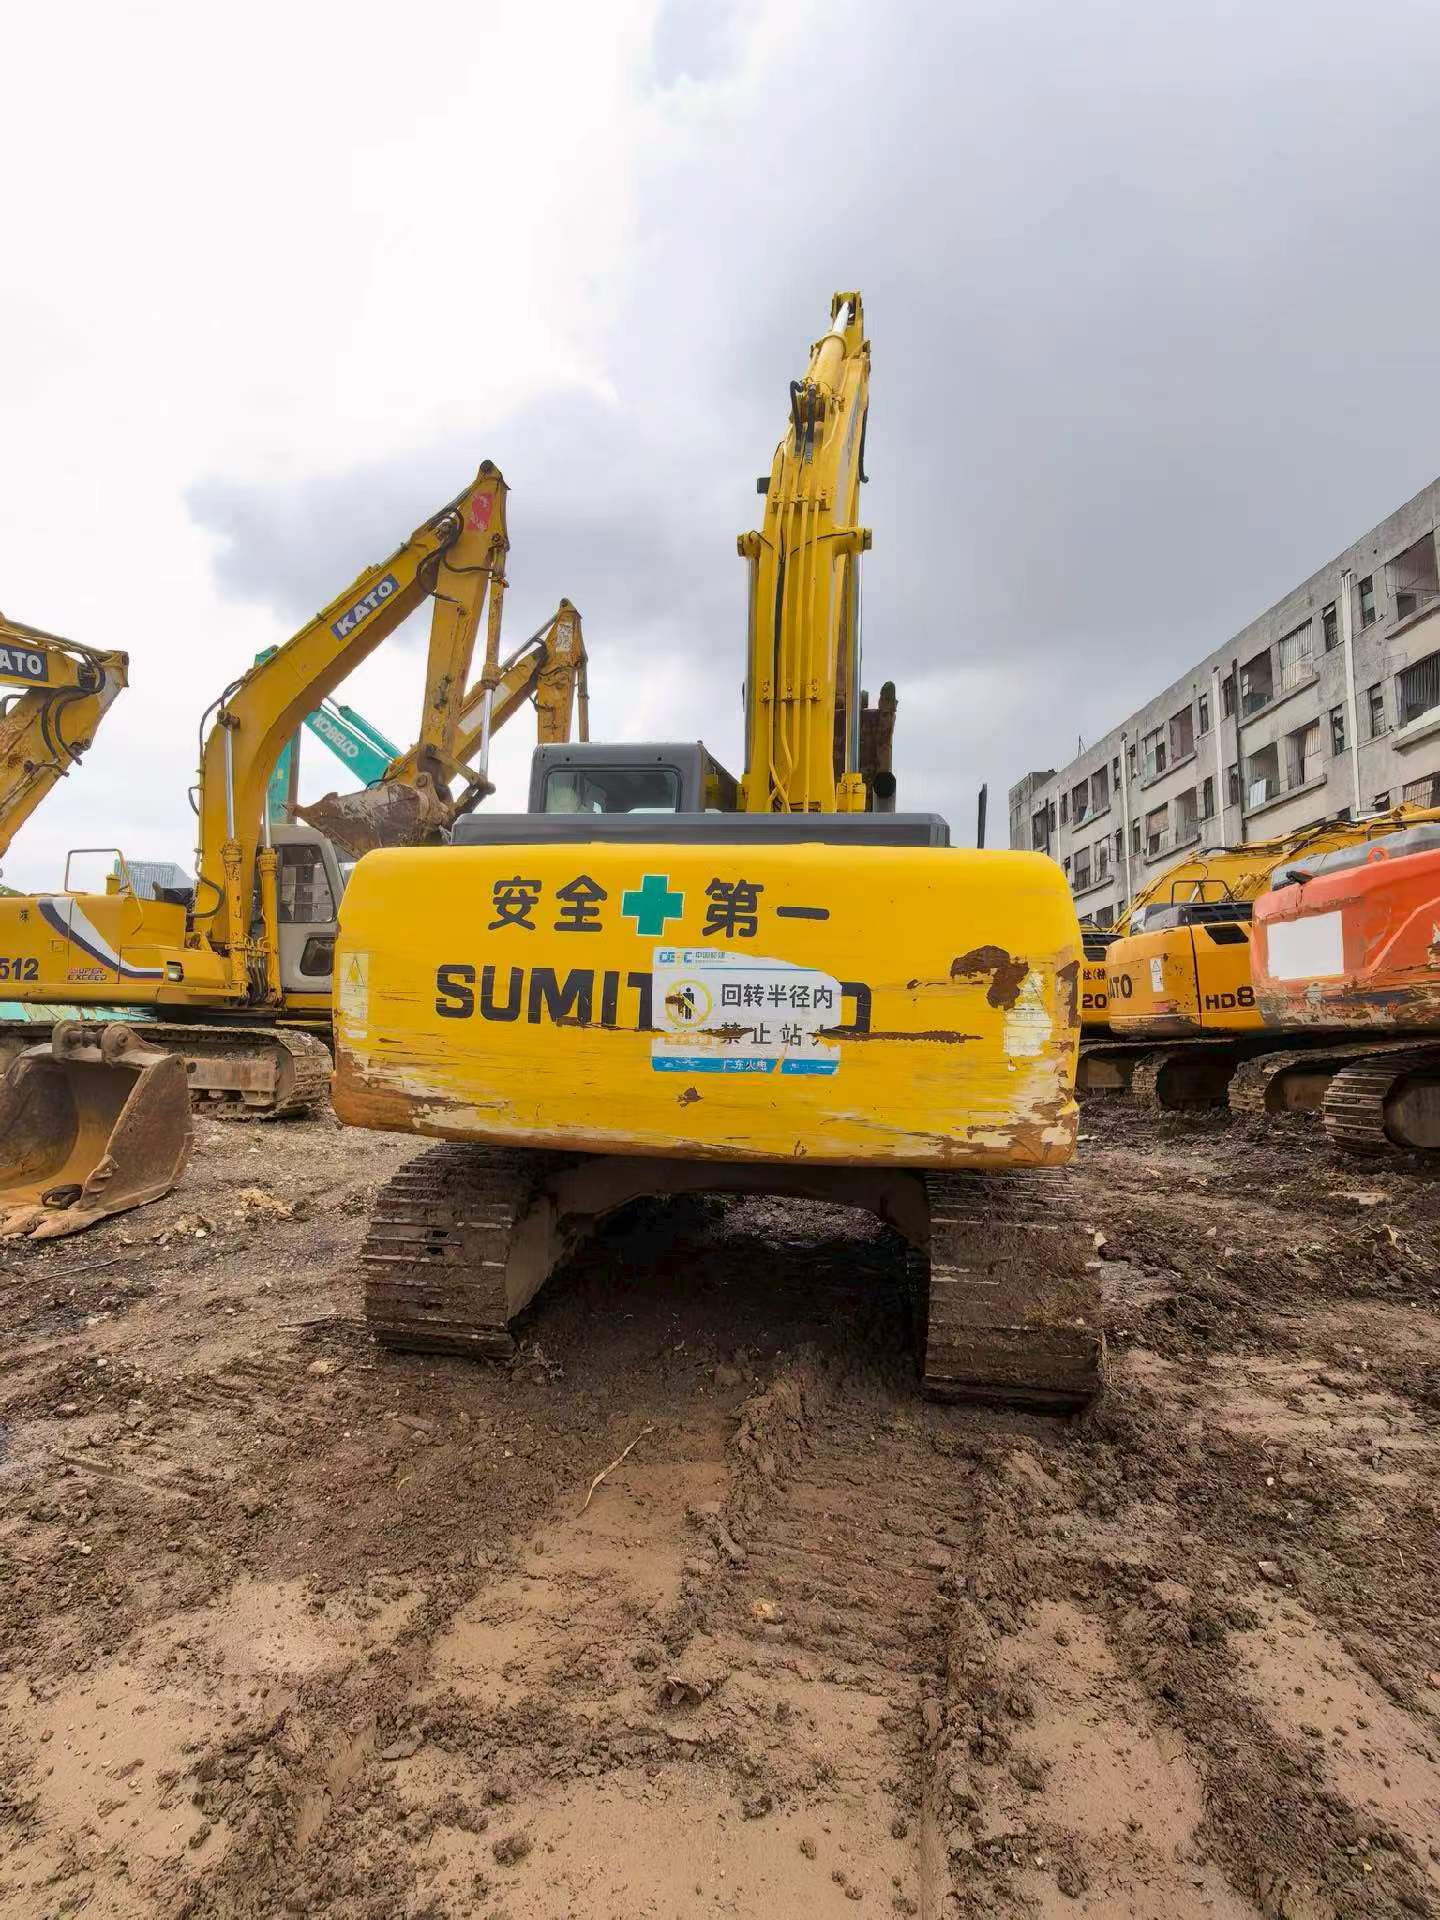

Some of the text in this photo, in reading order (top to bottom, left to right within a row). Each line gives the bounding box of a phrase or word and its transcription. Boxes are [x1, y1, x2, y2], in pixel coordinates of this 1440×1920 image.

[336, 581, 393, 637] KATO
[313, 713, 359, 758] KOBELCO
[487, 874, 830, 938] 安全 第一
[0, 957, 39, 980] 512
[436, 963, 872, 1035] SUMITO
[720, 983, 833, 1010] 回转半径内
[1107, 973, 1133, 1000] ATO
[1205, 985, 1256, 1010] HD8
[1081, 993, 1108, 1009] 20
